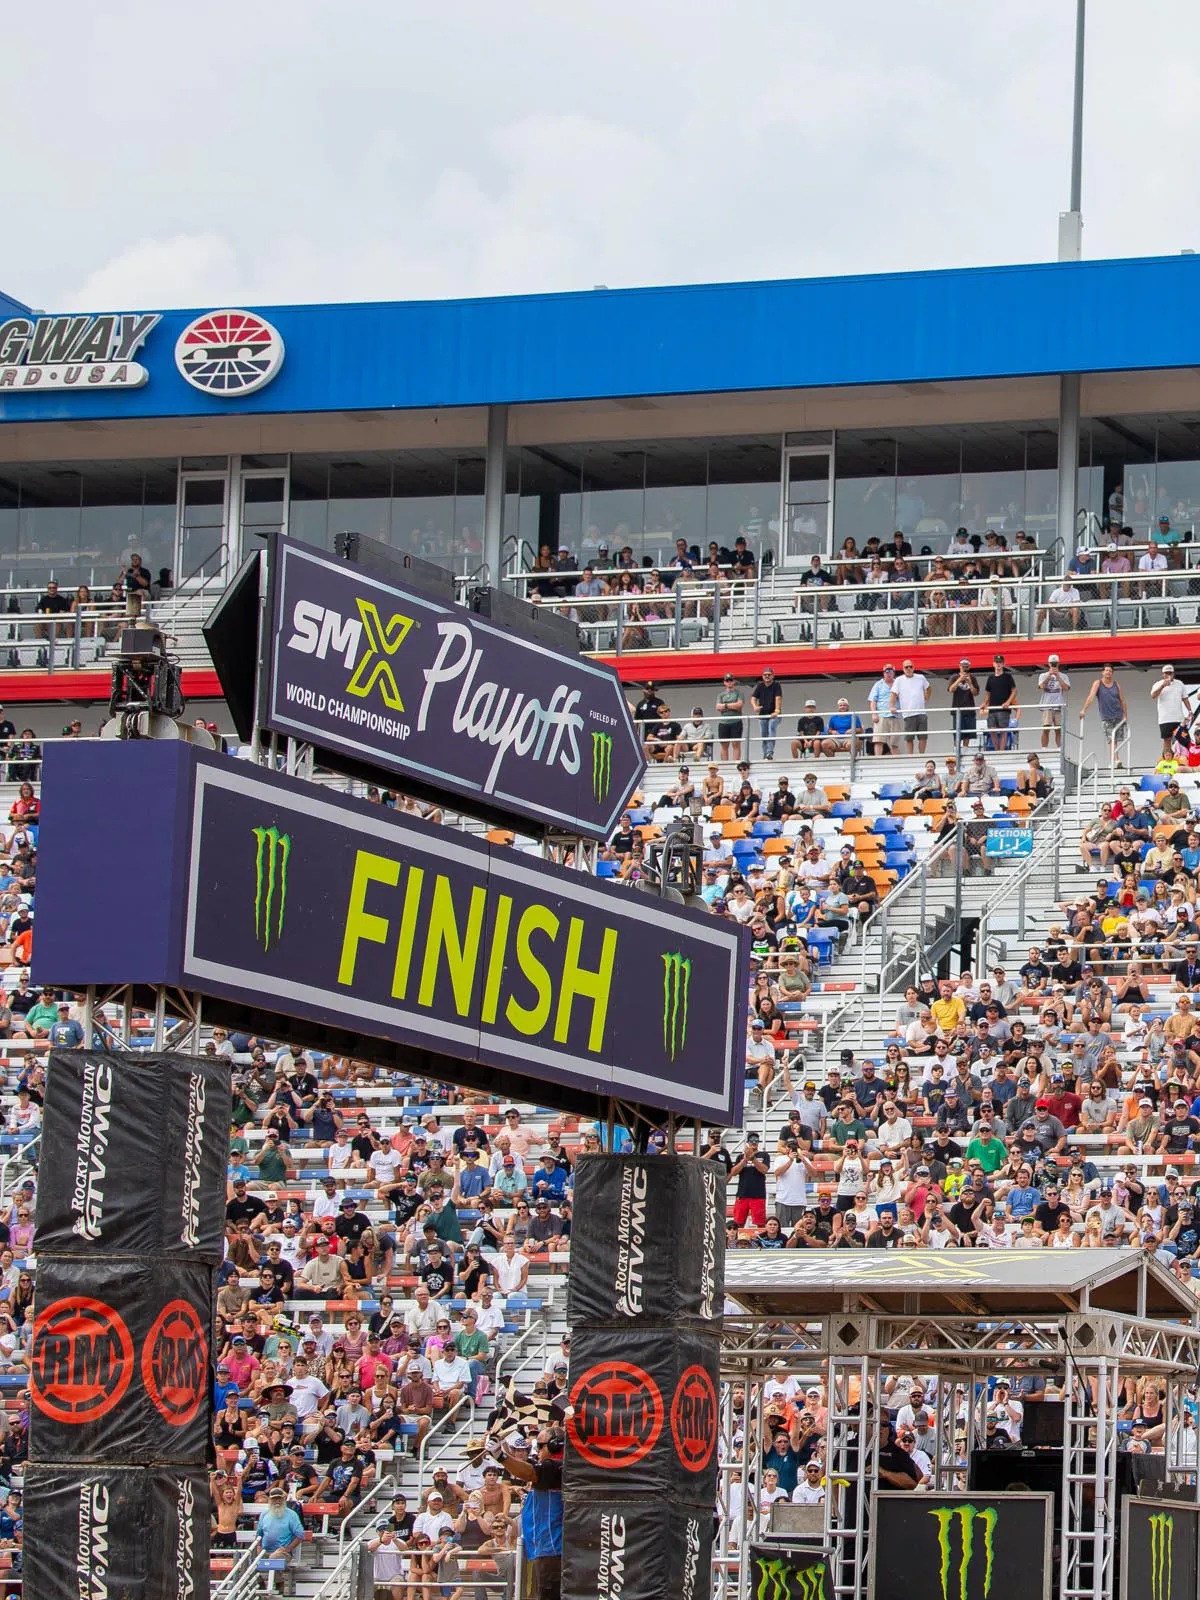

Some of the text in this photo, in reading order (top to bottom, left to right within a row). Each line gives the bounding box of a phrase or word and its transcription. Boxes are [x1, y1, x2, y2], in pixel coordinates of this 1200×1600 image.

[286, 682, 411, 742] WORLD CHAMPIONSHIP
[287, 597, 415, 713] SMX
[417, 621, 584, 795] Playoffs
[589, 710, 618, 726] FUELED BY
[988, 829, 1032, 838] SECTIONS
[337, 849, 619, 1053] FINISH
[71, 1062, 97, 1213] ROCKY MOUNTAIN
[182, 1071, 199, 1221] ROCKY MOUNTAIN
[615, 1166, 634, 1293] ROCKY MOUNTAIN
[701, 1171, 711, 1297] ROCKY MOUNTAIN
[77, 1482, 92, 1574] MOUNTAIN
[176, 1479, 185, 1572] MOUNTAIN
[597, 1513, 611, 1588] MOUNTAIN
